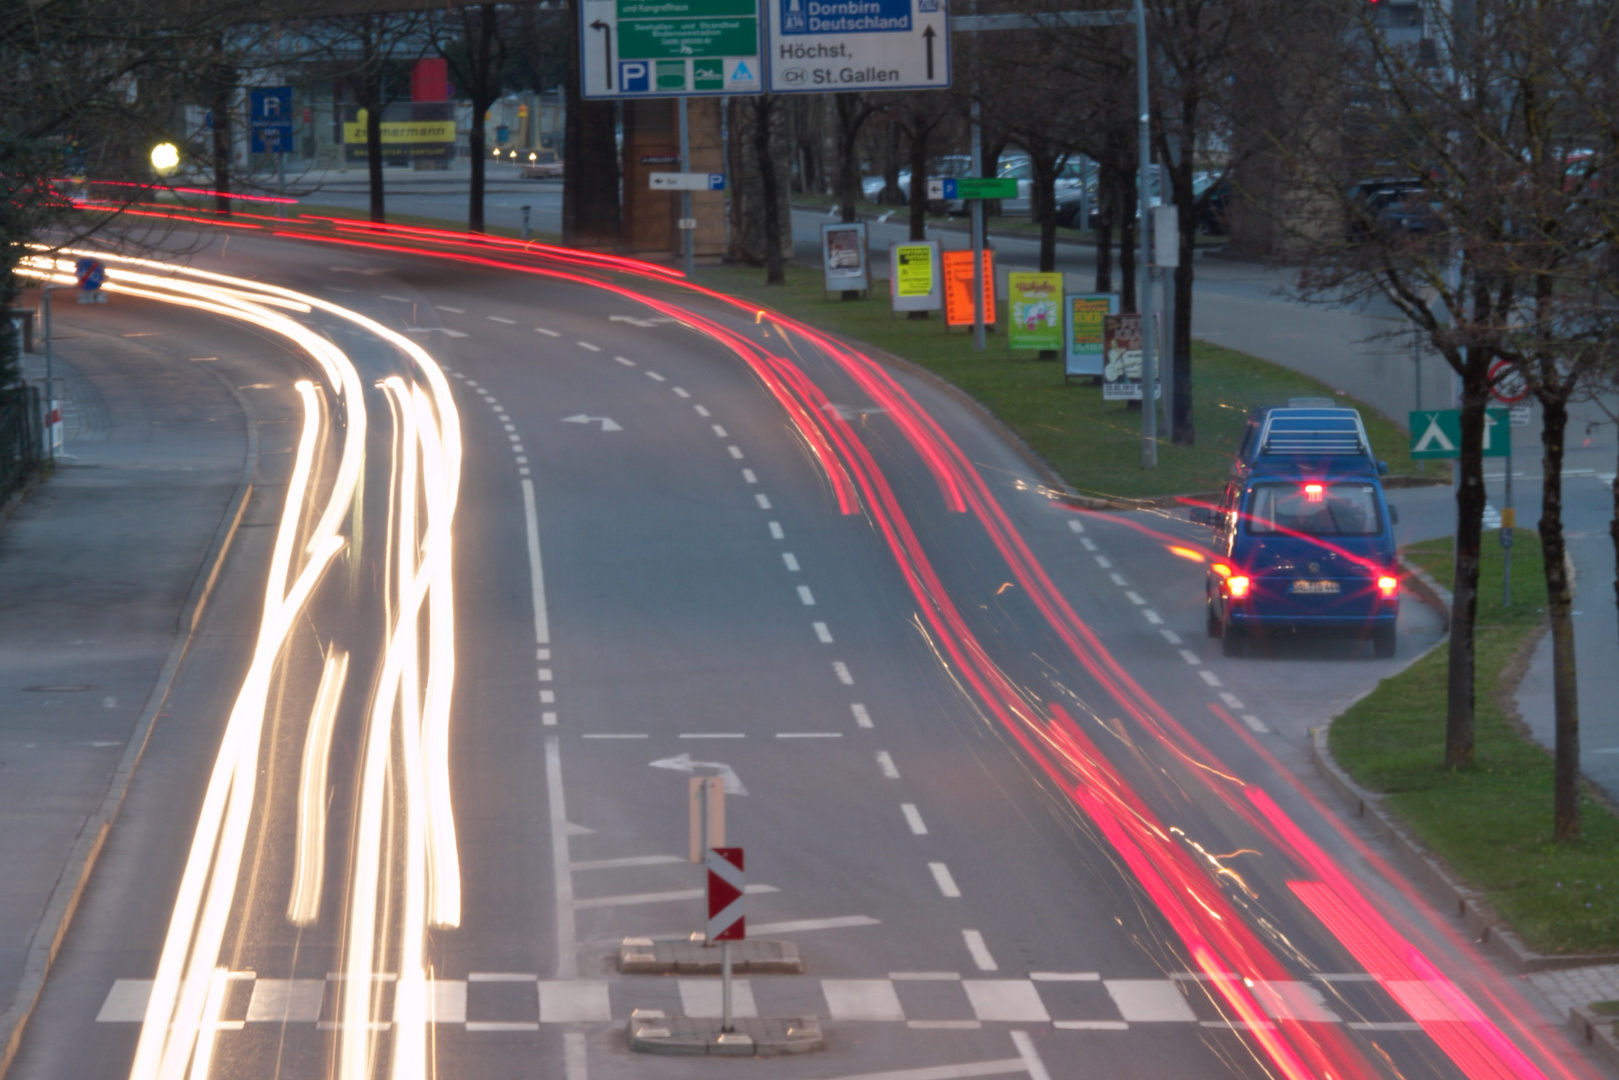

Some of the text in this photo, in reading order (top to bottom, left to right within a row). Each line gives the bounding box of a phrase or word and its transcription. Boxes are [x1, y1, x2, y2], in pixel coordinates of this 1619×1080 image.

[809, 2, 880, 16] Dornbirn
[809, 15, 918, 31] Deutschland
[780, 43, 853, 60] Höchst,
[622, 63, 646, 91] P
[785, 70, 804, 82] CH
[354, 124, 446, 138] zimermann
[710, 175, 723, 190] P
